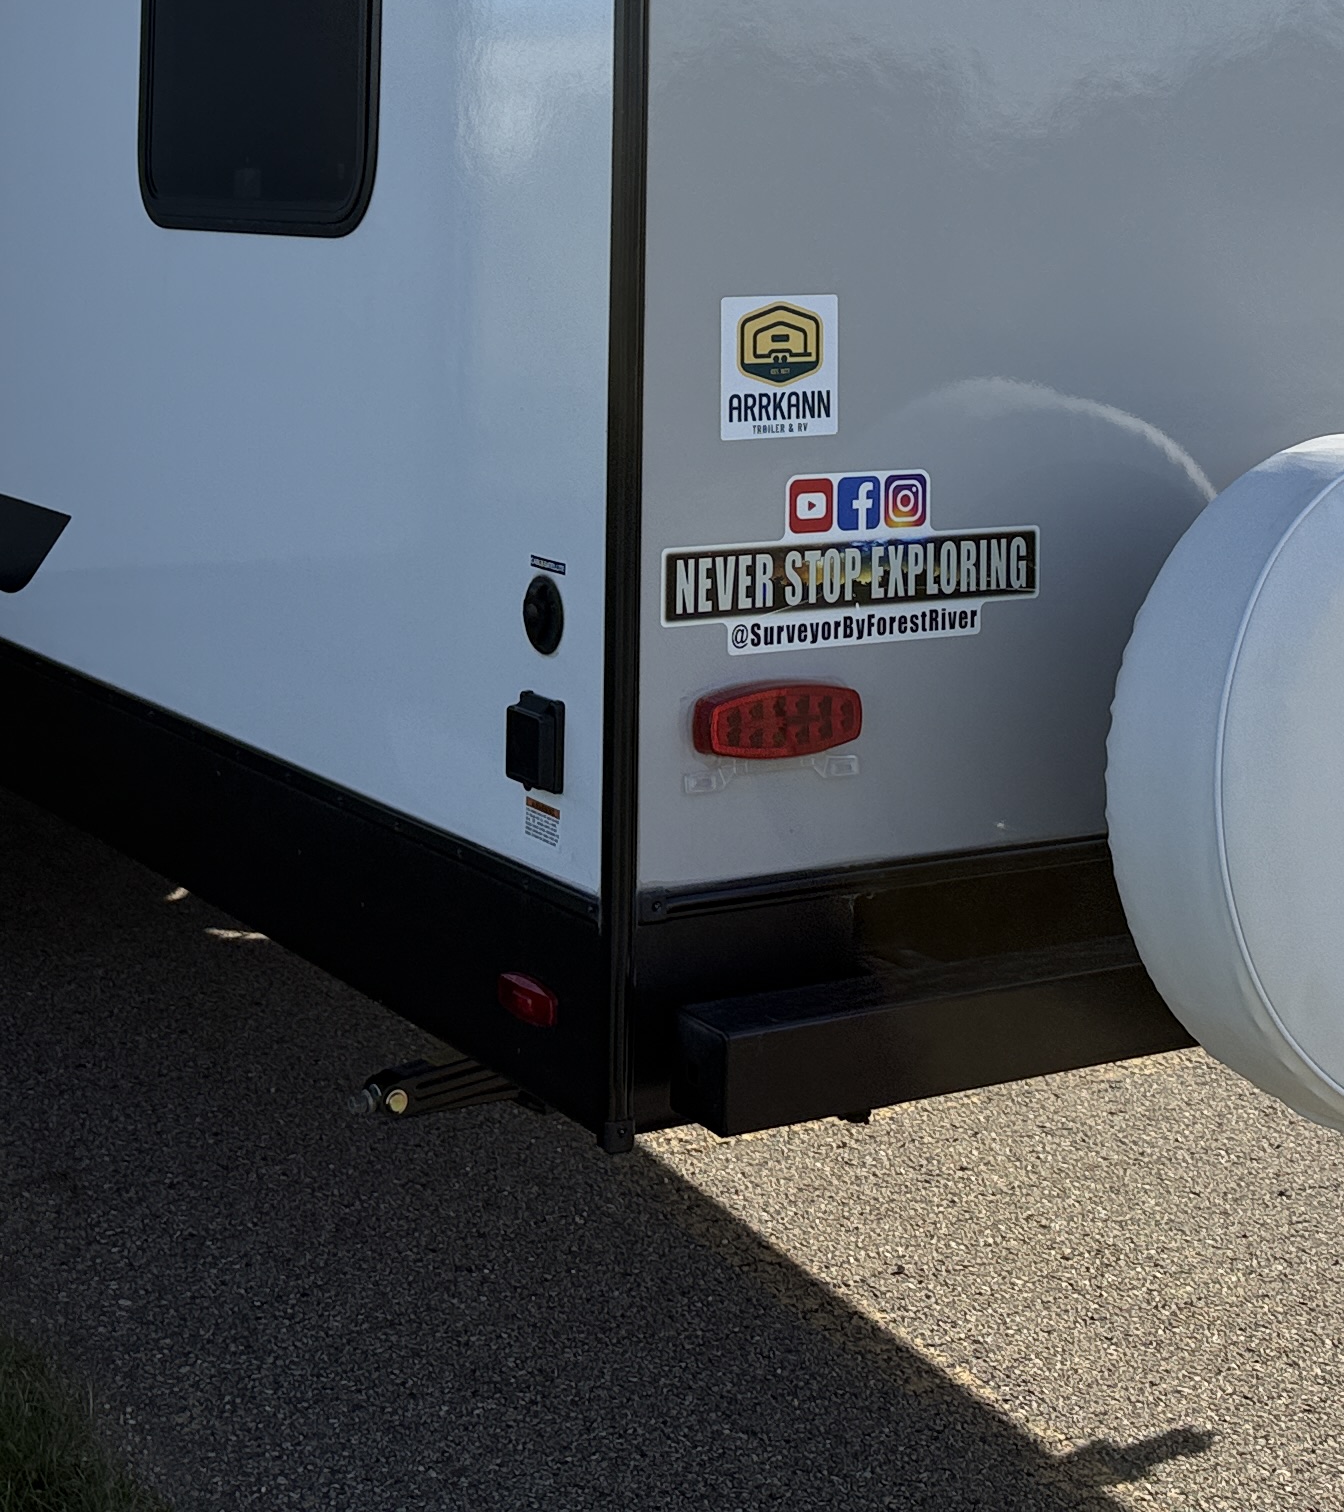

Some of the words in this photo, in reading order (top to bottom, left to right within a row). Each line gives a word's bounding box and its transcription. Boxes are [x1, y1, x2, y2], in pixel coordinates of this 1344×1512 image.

[728, 390, 831, 423] ARRKANN
[752, 424, 785, 434] TRAILER
[788, 423, 794, 432] &
[798, 422, 808, 432] RV
[675, 553, 774, 615] NEVER
[784, 551, 862, 605] STOP
[871, 536, 1028, 600] EXPLORING
[731, 608, 978, 650] @SurveyorByForestRiver
